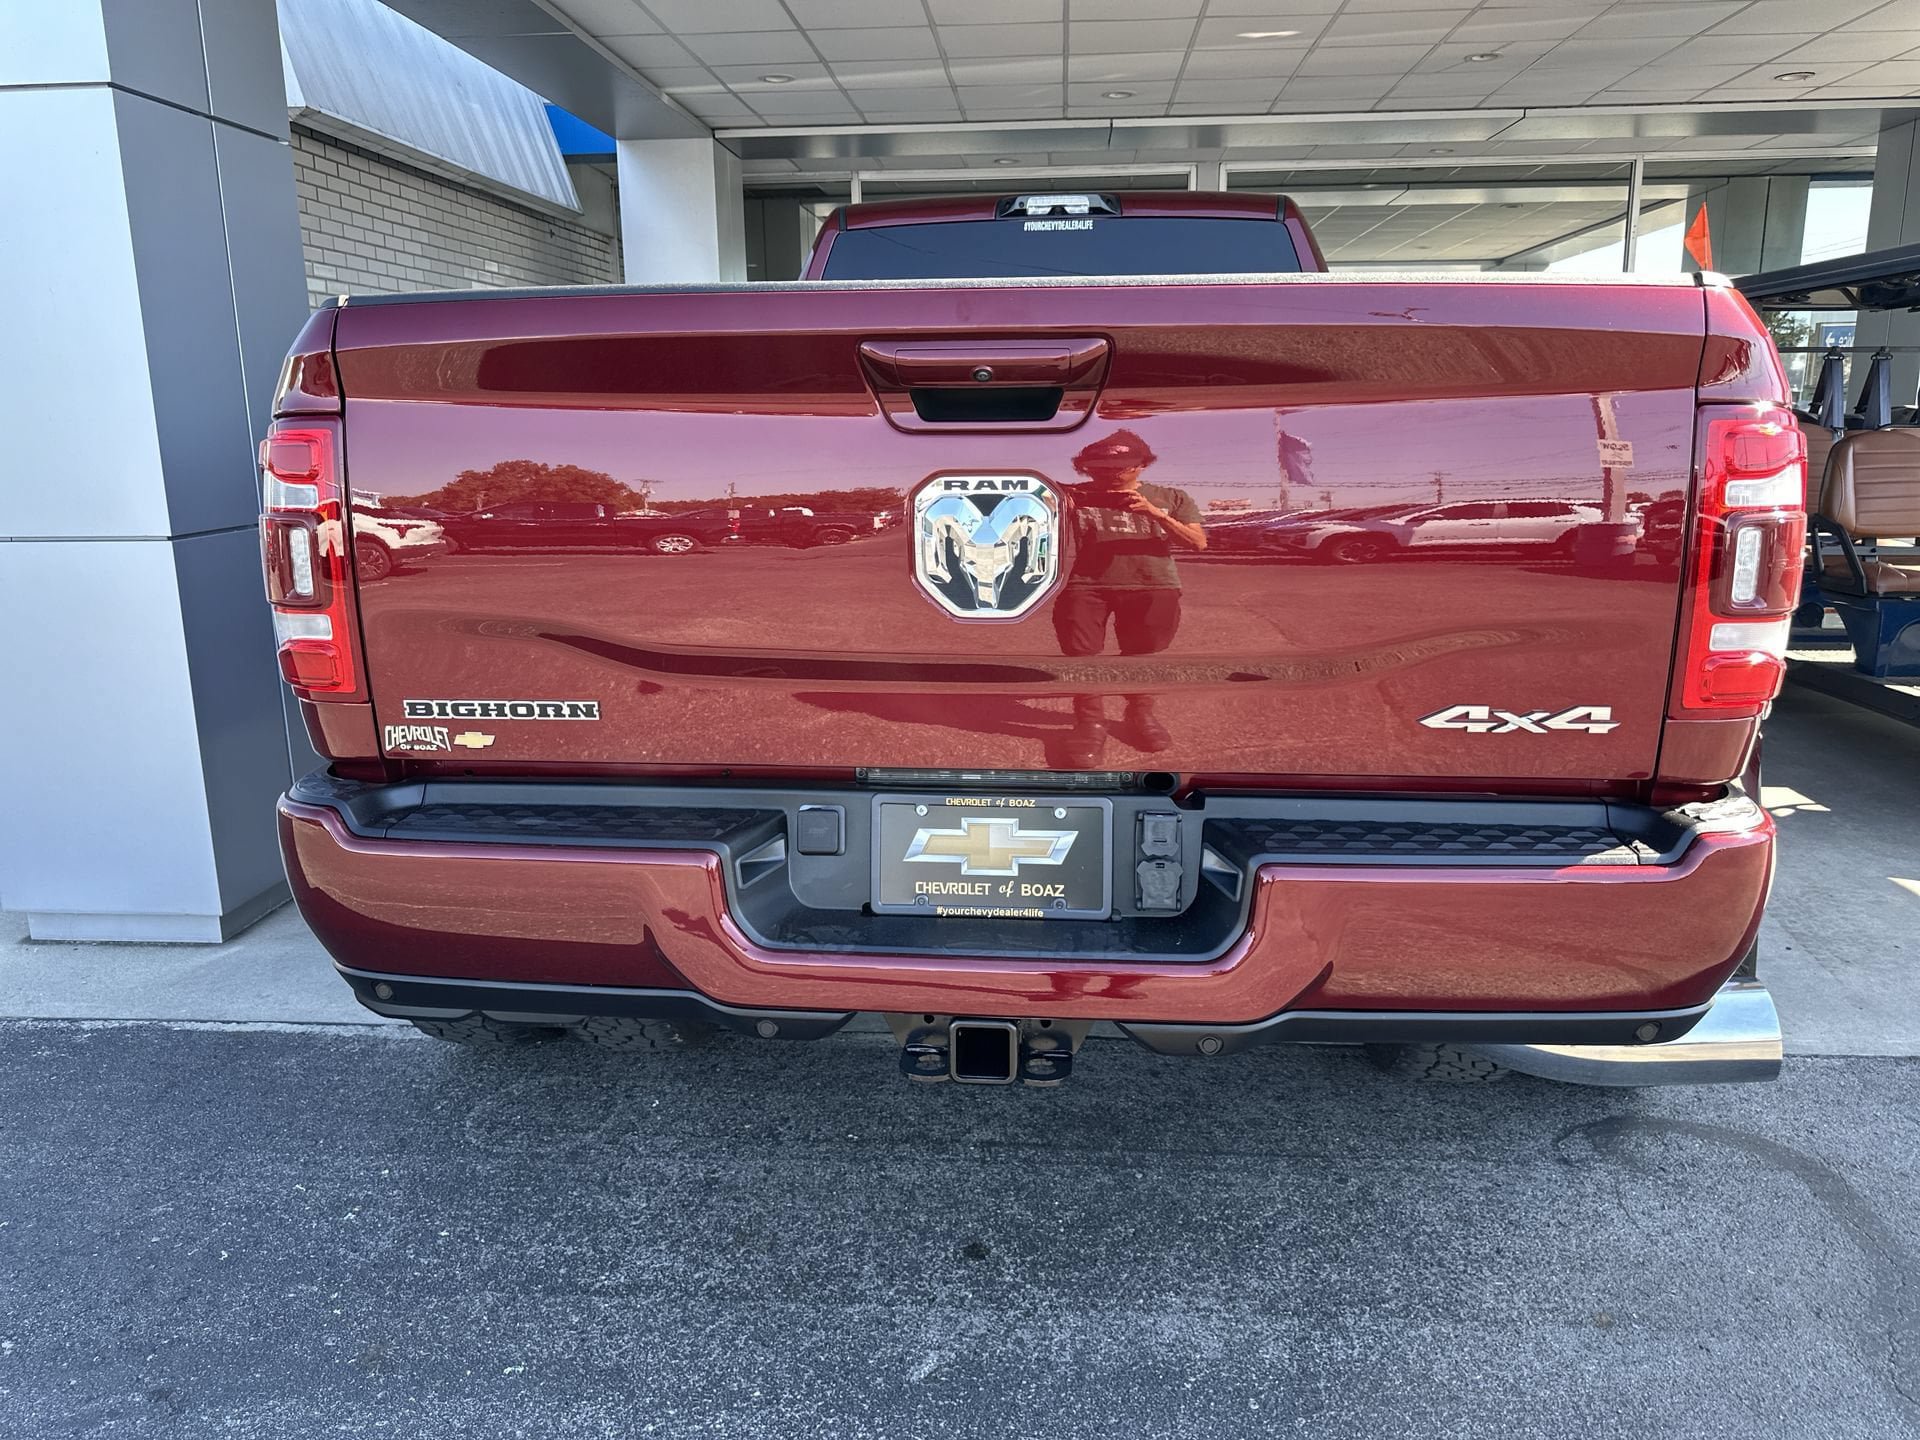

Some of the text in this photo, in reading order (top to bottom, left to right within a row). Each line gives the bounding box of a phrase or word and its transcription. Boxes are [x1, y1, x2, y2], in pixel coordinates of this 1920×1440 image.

[943, 479, 1029, 491] RAM
[403, 700, 600, 720] BIGHORN
[1416, 704, 1621, 734] 4x4
[384, 725, 452, 752] CHEVROLET
[945, 797, 1036, 808] CHEVROLET of BOAZ
[915, 881, 1065, 897] CHEVROLET of BOAZ
[936, 905, 1044, 919] #yourchevydealer4life
